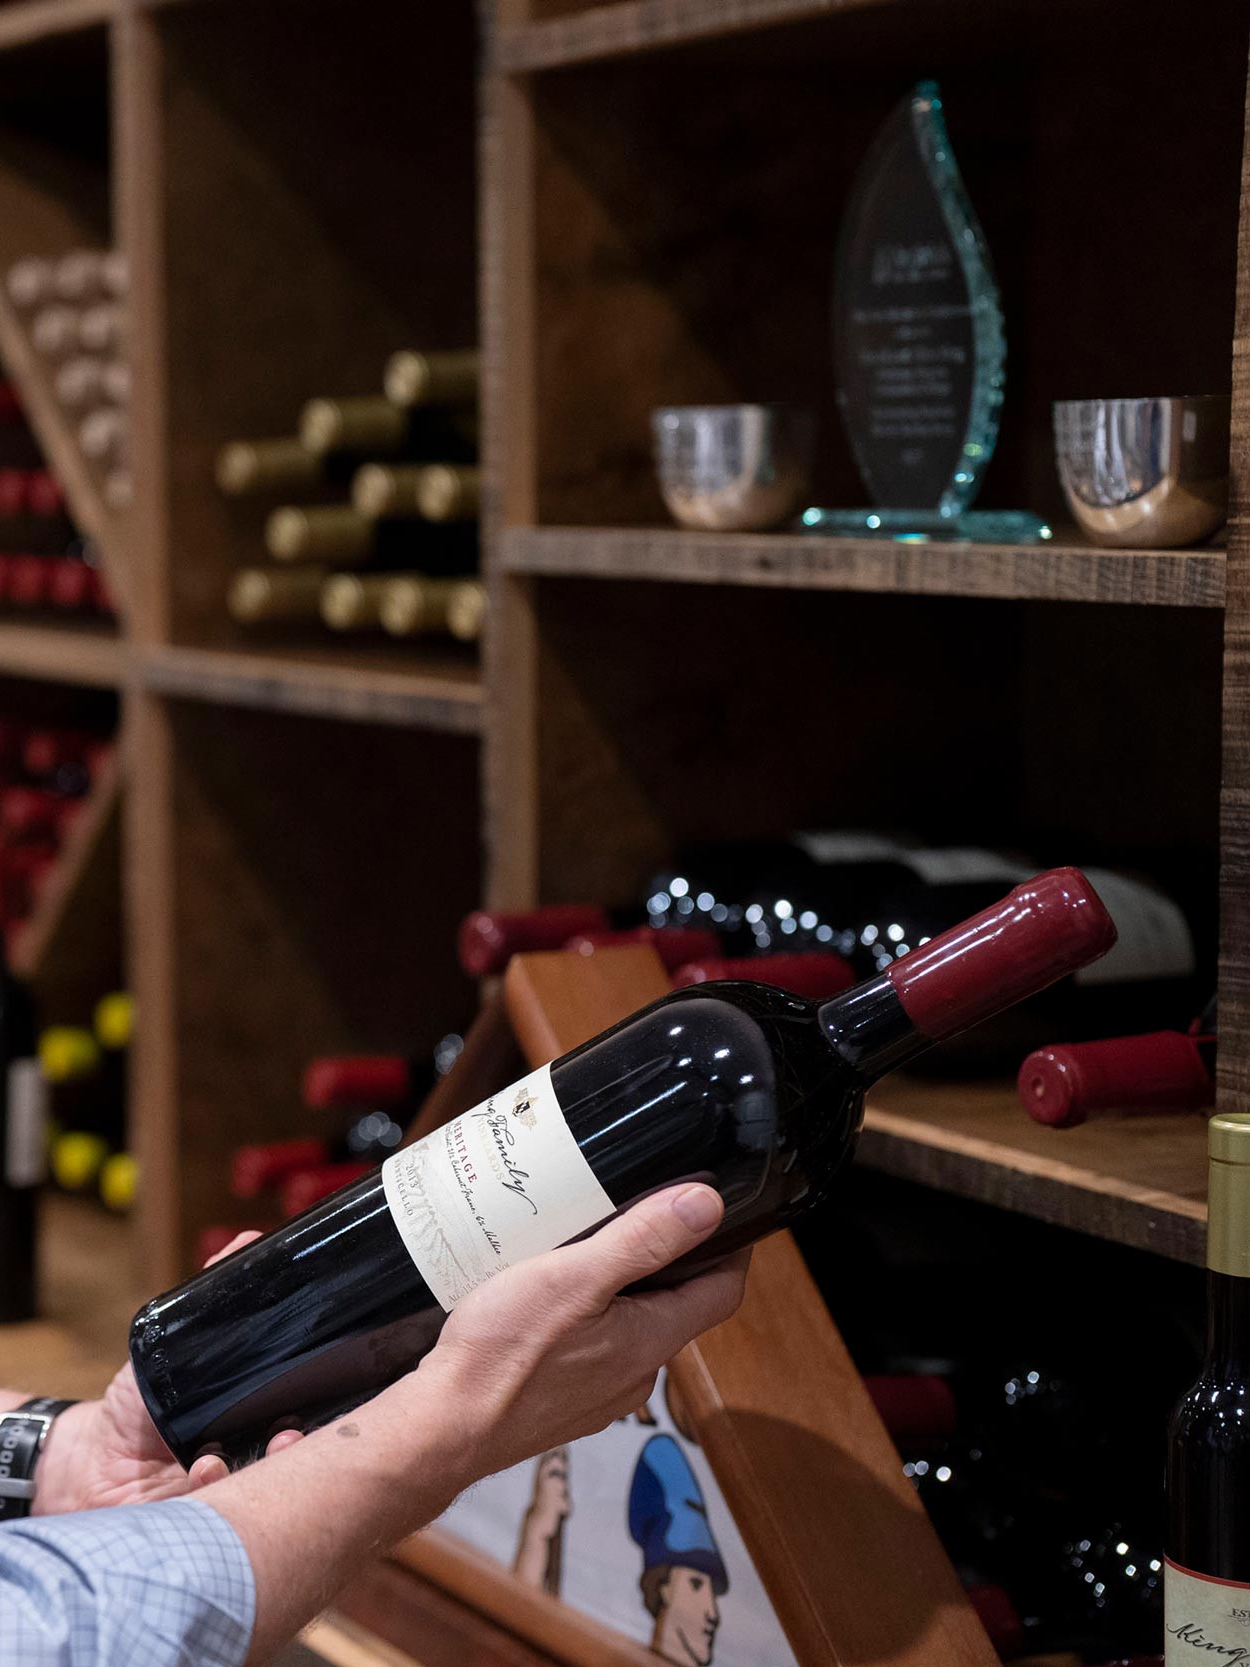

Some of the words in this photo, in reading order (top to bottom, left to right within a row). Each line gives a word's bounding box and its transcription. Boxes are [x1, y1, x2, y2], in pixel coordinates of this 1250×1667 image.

[405, 1164, 418, 1188] 2013
[453, 1120, 478, 1183] MERITAGE
[487, 1115, 537, 1215] Family
